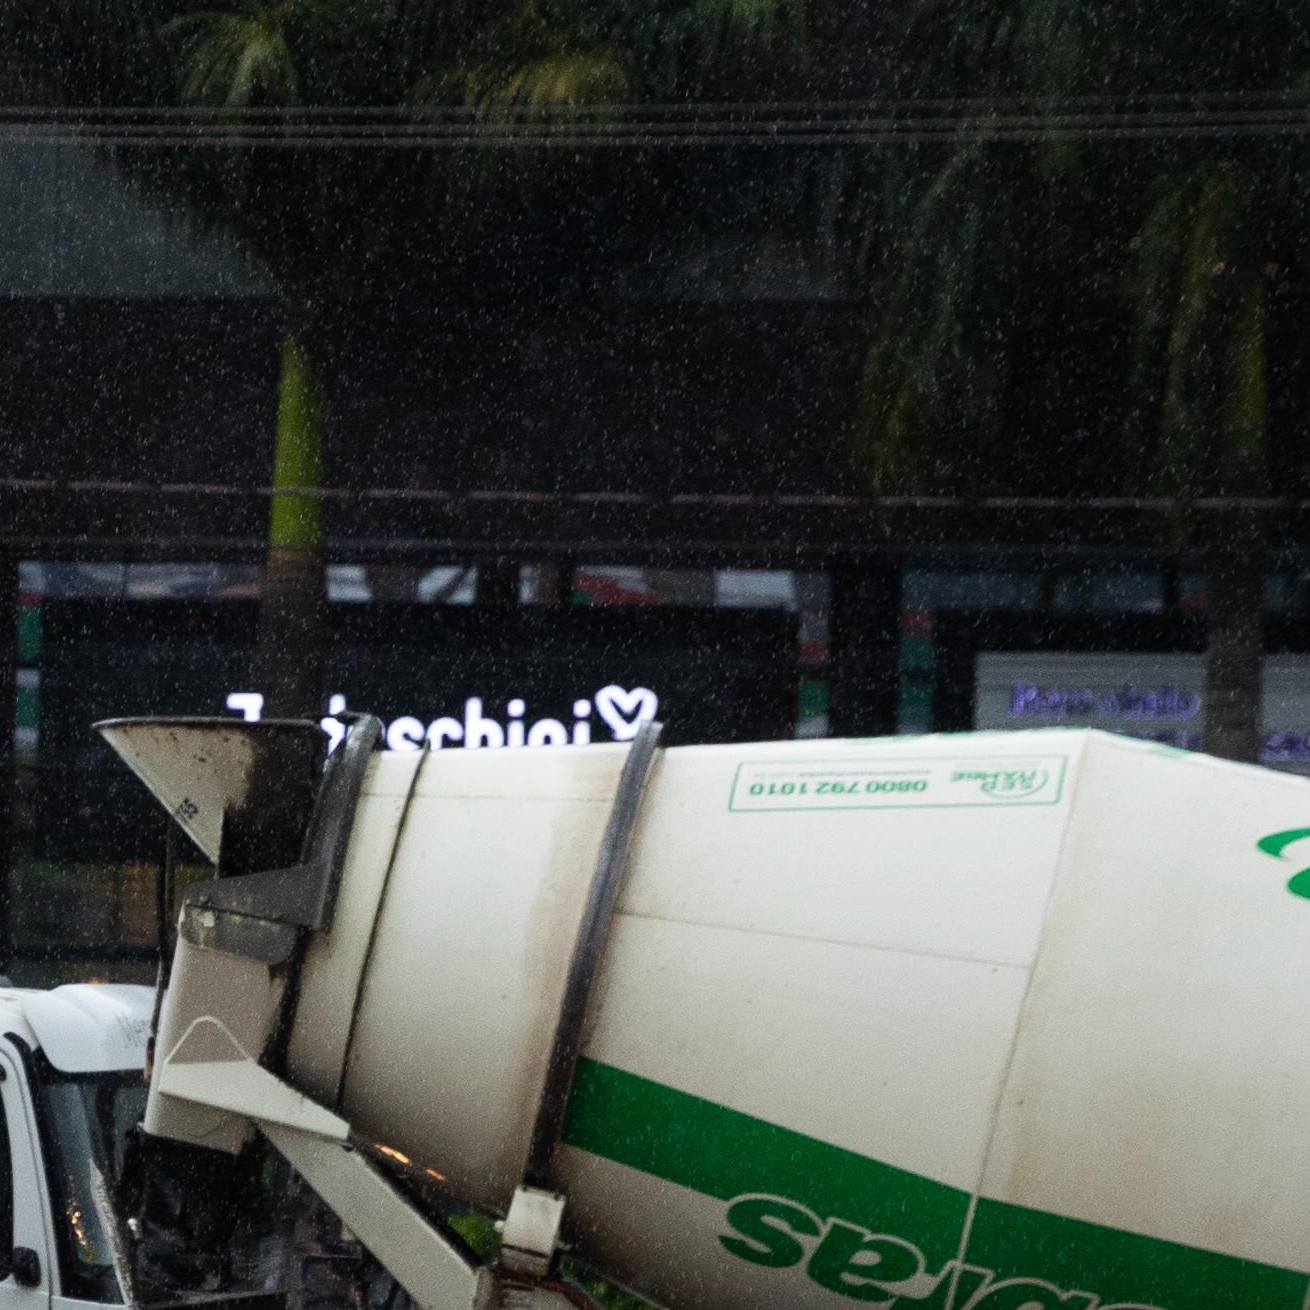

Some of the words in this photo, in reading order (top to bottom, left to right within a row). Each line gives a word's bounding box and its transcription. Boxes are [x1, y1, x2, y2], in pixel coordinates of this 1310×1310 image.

[749, 781, 809, 797] 1010
[814, 780, 861, 797] 792
[865, 780, 928, 796] 0800
